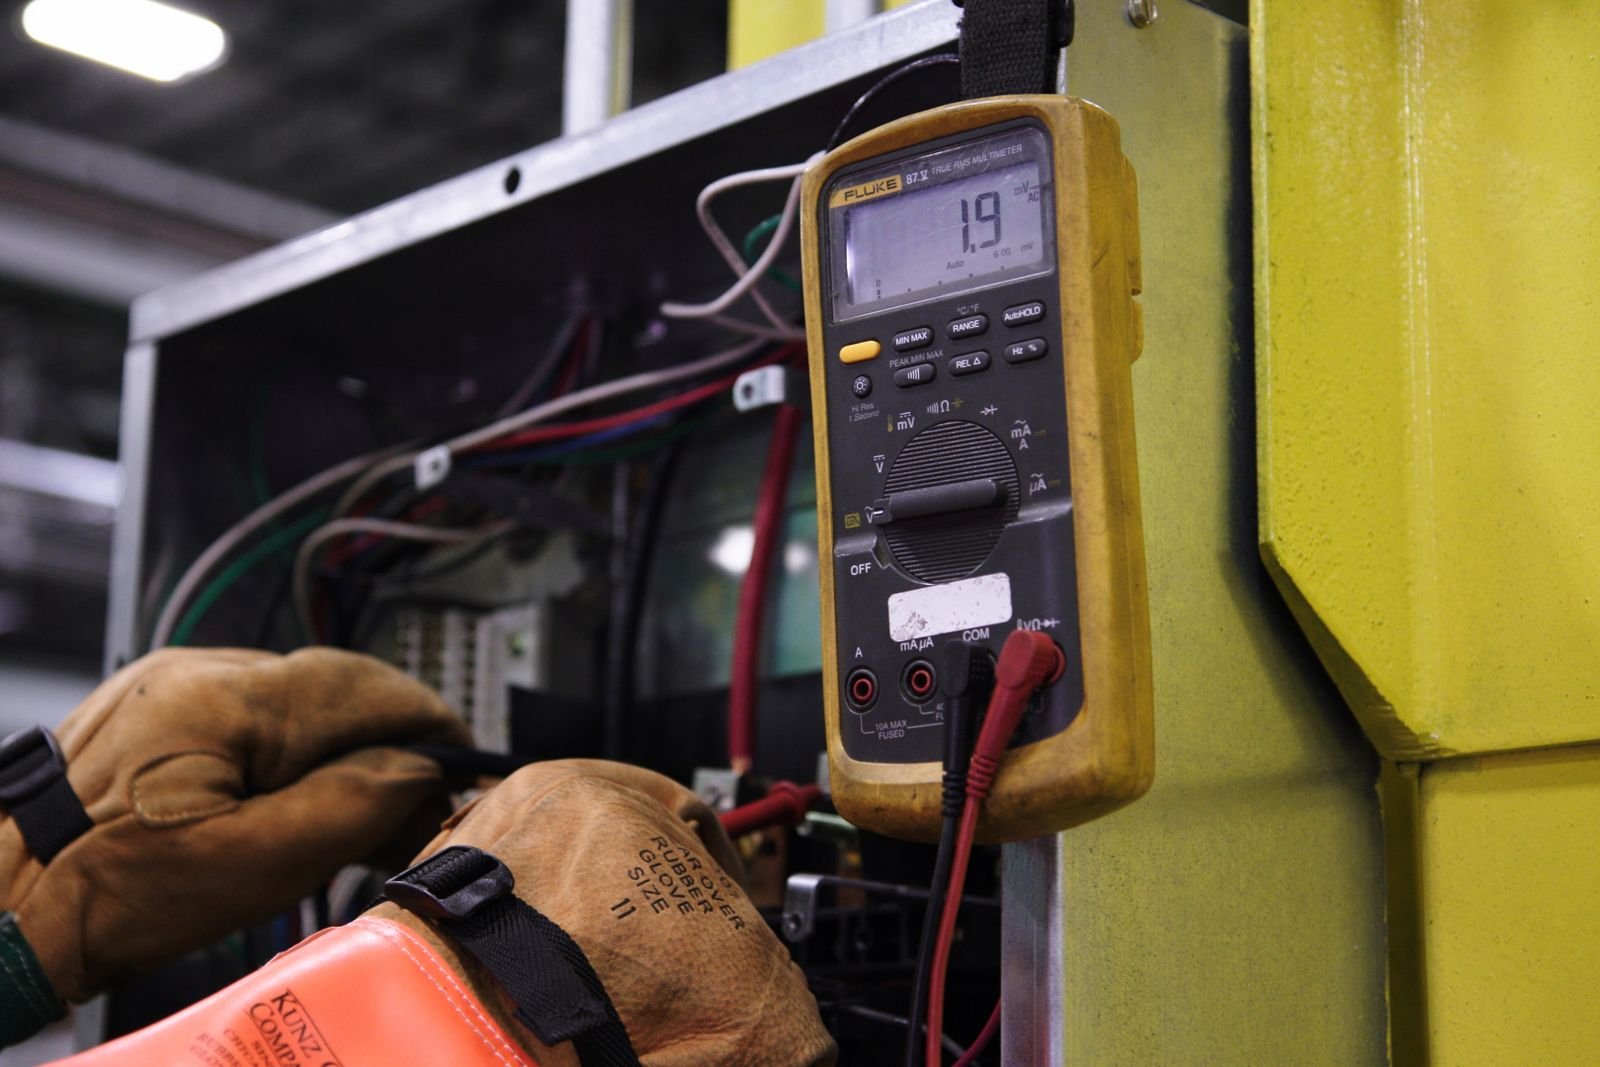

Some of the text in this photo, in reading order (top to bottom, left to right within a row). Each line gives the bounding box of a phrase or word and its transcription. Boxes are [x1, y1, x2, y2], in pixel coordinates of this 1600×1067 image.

[931, 163, 952, 175] TRUE
[953, 157, 971, 169] RMS
[972, 144, 1023, 165] MULTIMETER
[844, 178, 898, 202] FLUKE
[1028, 190, 1039, 203] AC
[960, 191, 1001, 254] 1.9
[946, 260, 965, 271] Auto
[1004, 306, 1041, 322] AutoHOLD
[952, 319, 980, 333] RANGE
[895, 331, 928, 346] MIN MAX
[1012, 346, 1024, 356] Hz
[889, 349, 944, 369] PEAK MIN MAX
[956, 359, 972, 369] REL
[854, 410, 880, 422] Second
[897, 416, 915, 431] mV
[1011, 424, 1032, 439] mA
[1019, 438, 1029, 451] A
[850, 562, 872, 576] OFF
[963, 628, 990, 641] COM
[855, 647, 863, 658] A
[900, 638, 918, 652] mA
[875, 719, 907, 731] 10A MAX
[878, 729, 905, 740] FUSED
[638, 849, 695, 916] GLOVE
[650, 835, 714, 915] RUBBER
[627, 866, 670, 914] SIZE
[610, 898, 637, 920] 11
[700, 875, 746, 930] OVER
[271, 992, 322, 1060] KUNZ
